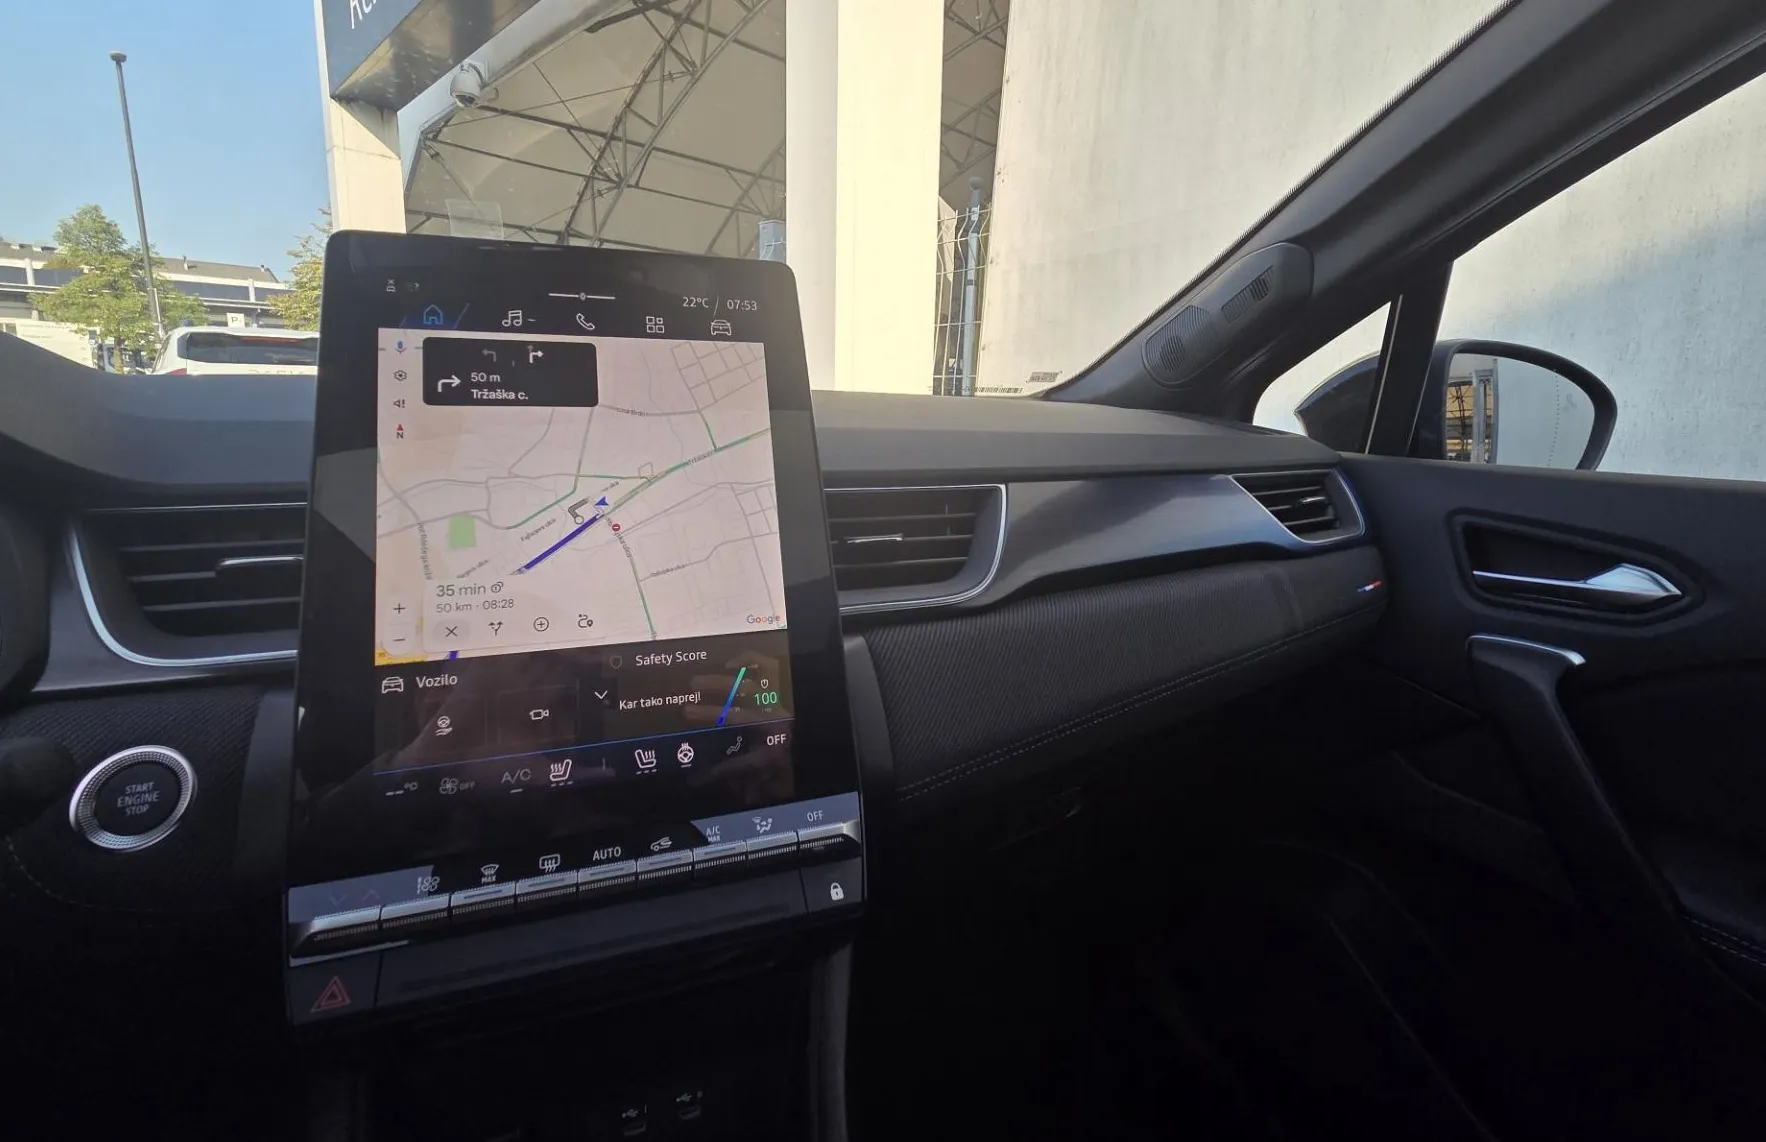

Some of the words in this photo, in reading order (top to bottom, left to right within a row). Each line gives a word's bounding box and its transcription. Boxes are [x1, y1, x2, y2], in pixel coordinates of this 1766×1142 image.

[726, 299, 758, 311] 07:53
[470, 372, 487, 382] 50
[489, 374, 500, 382] m
[470, 388, 516, 400] Tržaška
[518, 390, 529, 400] c.
[435, 584, 455, 597] 35
[458, 583, 487, 596] min
[435, 603, 452, 614] 50
[455, 601, 472, 612] km
[482, 598, 515, 611] 08:28
[746, 613, 781, 625] Google
[635, 651, 673, 667] Safety
[675, 650, 708, 662] Score
[416, 674, 458, 689] Vozilo
[619, 699, 637, 710] Kar
[639, 696, 663, 708] tako
[665, 691, 701, 707] naprej!
[754, 691, 777, 706] 100
[766, 733, 787, 746] OFF
[501, 768, 532, 784] A/C
[125, 781, 155, 795] START
[117, 791, 161, 808] ENGINE
[124, 804, 150, 817] STOP
[806, 810, 824, 822] OFF
[705, 825, 721, 836] A/C
[592, 846, 622, 861] AUTO
[481, 875, 497, 884] MAX
